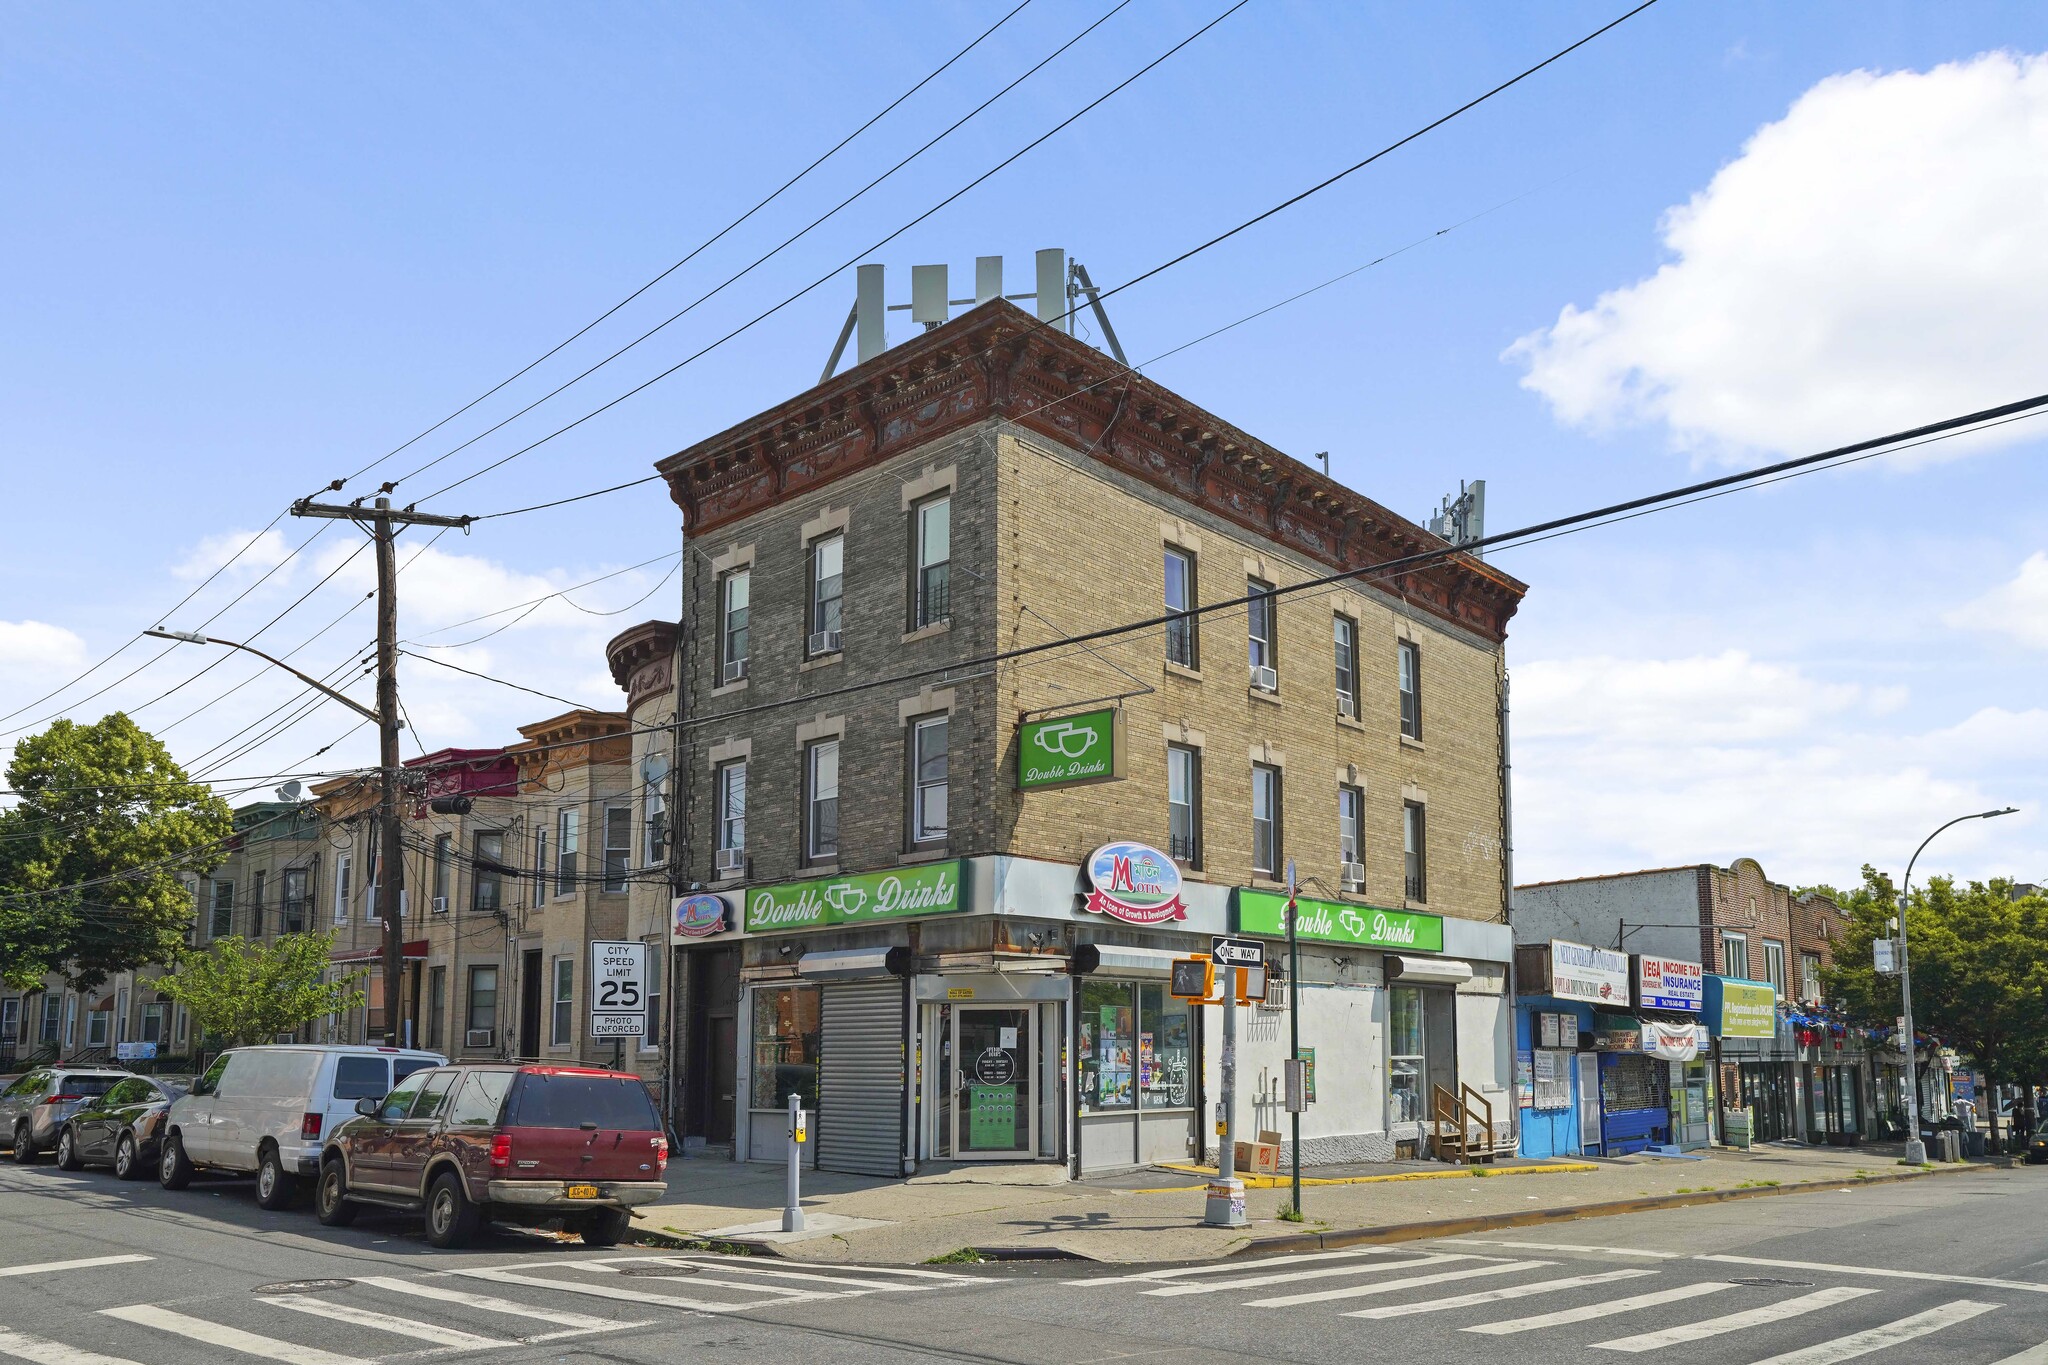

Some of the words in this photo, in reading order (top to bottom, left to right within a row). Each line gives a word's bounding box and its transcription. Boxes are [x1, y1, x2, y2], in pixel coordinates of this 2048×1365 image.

[1025, 765, 1065, 782] Double
[1066, 760, 1105, 777] Drinks
[749, 888, 823, 926] Double
[872, 872, 956, 914] Drinks
[1099, 896, 1107, 906] An
[1107, 900, 1118, 913] Icon
[1119, 907, 1125, 915] of
[1125, 909, 1143, 920] Growth
[1143, 912, 1147, 920] &
[1147, 903, 1177, 920] Development
[1370, 913, 1415, 944] Drinks
[607, 946, 630, 955] CITY
[1220, 946, 1235, 958] ONE
[1240, 948, 1256, 960] WAY
[1560, 944, 1571, 965] NEXT
[603, 957, 635, 966] SPEED
[1642, 959, 1661, 980] VEGA
[1662, 961, 1688, 976] INCOME
[1688, 965, 1701, 977] TAX
[606, 968, 632, 977] LIMIT
[1554, 976, 1571, 994] POPULAR
[1585, 981, 1600, 998] SCHOOL
[1662, 975, 1701, 991] INSURANCE
[599, 980, 640, 1007] 25
[1668, 989, 1679, 997] REAL
[1679, 991, 1695, 999] ESTATE
[596, 1025, 640, 1033] ENFORCED
[604, 1017, 632, 1025] PHOTO
